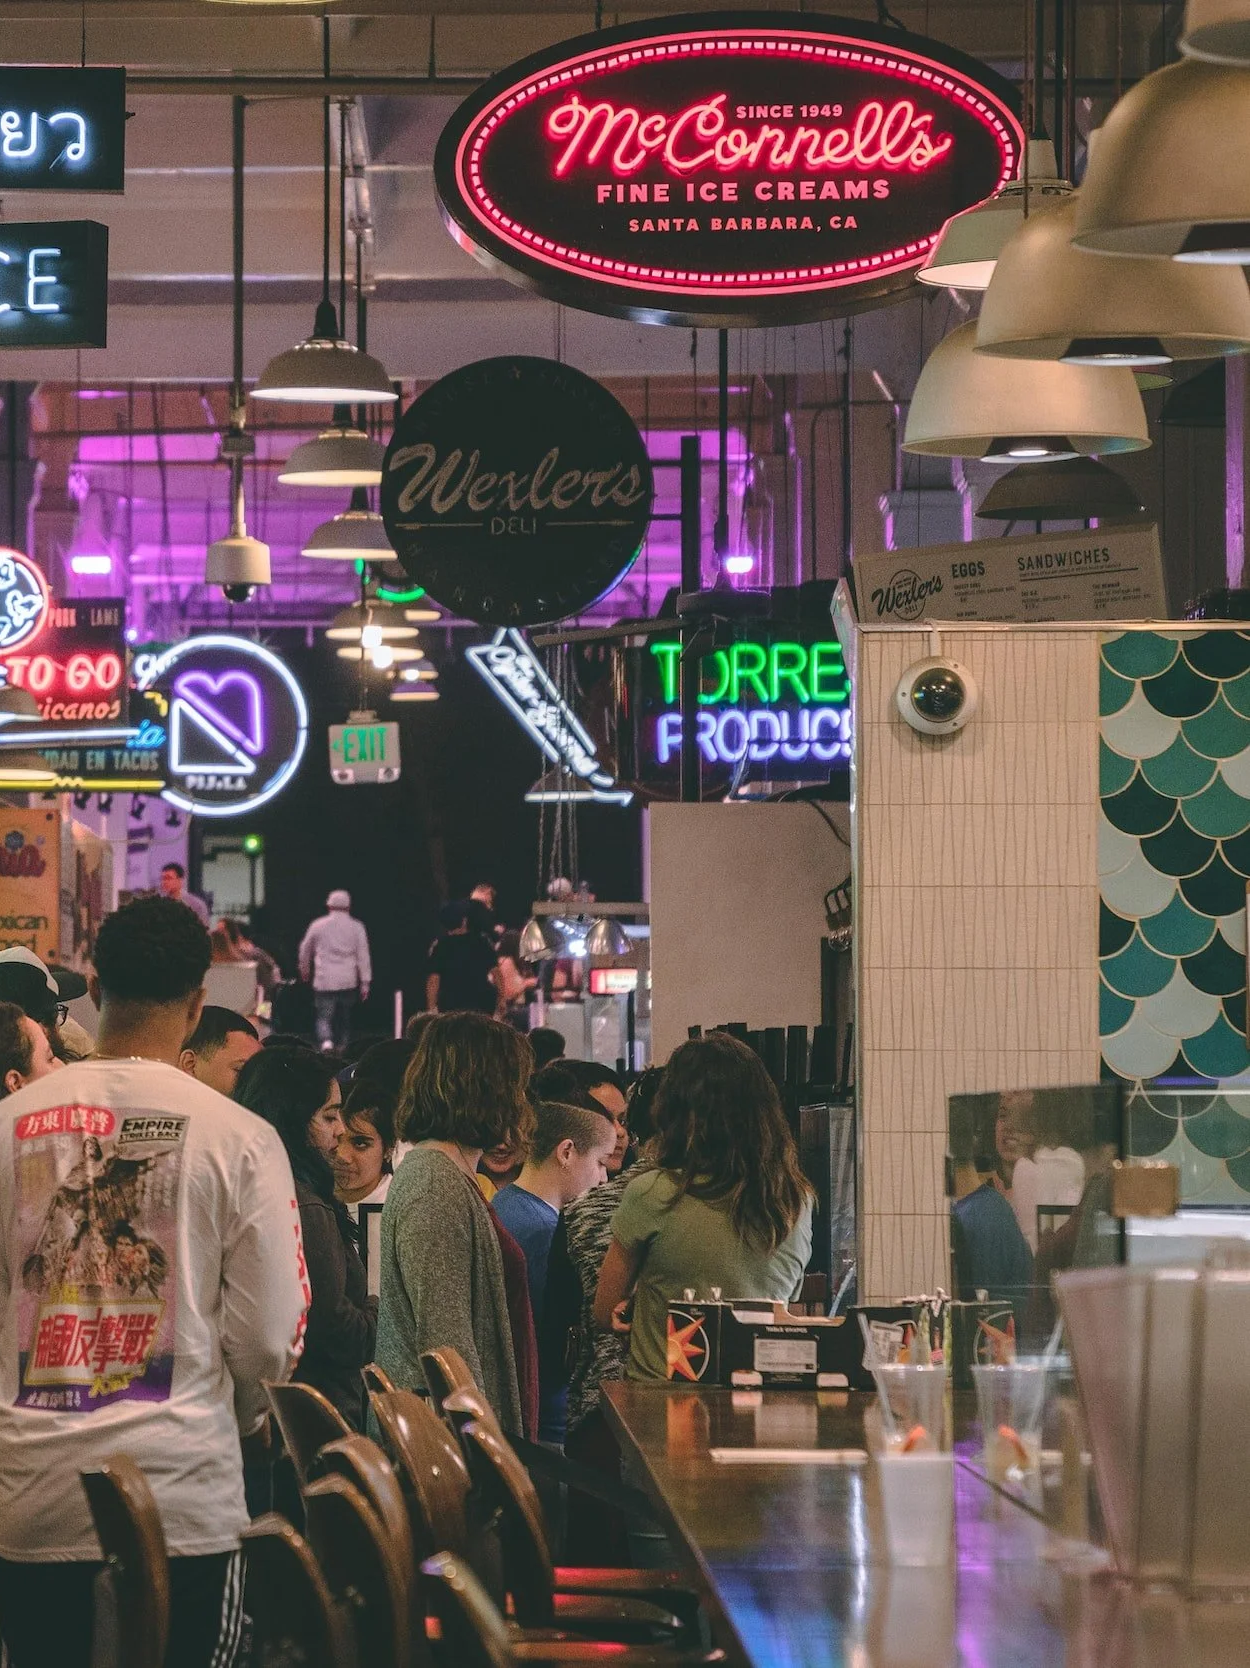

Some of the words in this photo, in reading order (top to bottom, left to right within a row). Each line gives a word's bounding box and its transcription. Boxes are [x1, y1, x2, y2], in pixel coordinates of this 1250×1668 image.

[736, 105, 794, 119] SINCE
[799, 103, 843, 118] 1949
[548, 93, 951, 177] McConnell's
[596, 183, 670, 203] FINE
[686, 182, 739, 202] ICE
[755, 179, 891, 201] CREAMS
[629, 217, 700, 233] SANTA
[711, 216, 822, 234] BARBARA,
[830, 215, 858, 230] CA
[490, 516, 537, 536] DELI
[952, 561, 985, 578] EGGS
[1017, 548, 1110, 571] SANDWICHES
[871, 575, 943, 616] Wexler's
[6, 654, 53, 690] TO
[68, 653, 121, 690] GO
[650, 642, 852, 704] TORRE
[38, 697, 120, 720] icanos
[343, 727, 386, 763] EXIT
[113, 751, 158, 770] TACOS
[121, 1117, 184, 1132] EMPIRE
